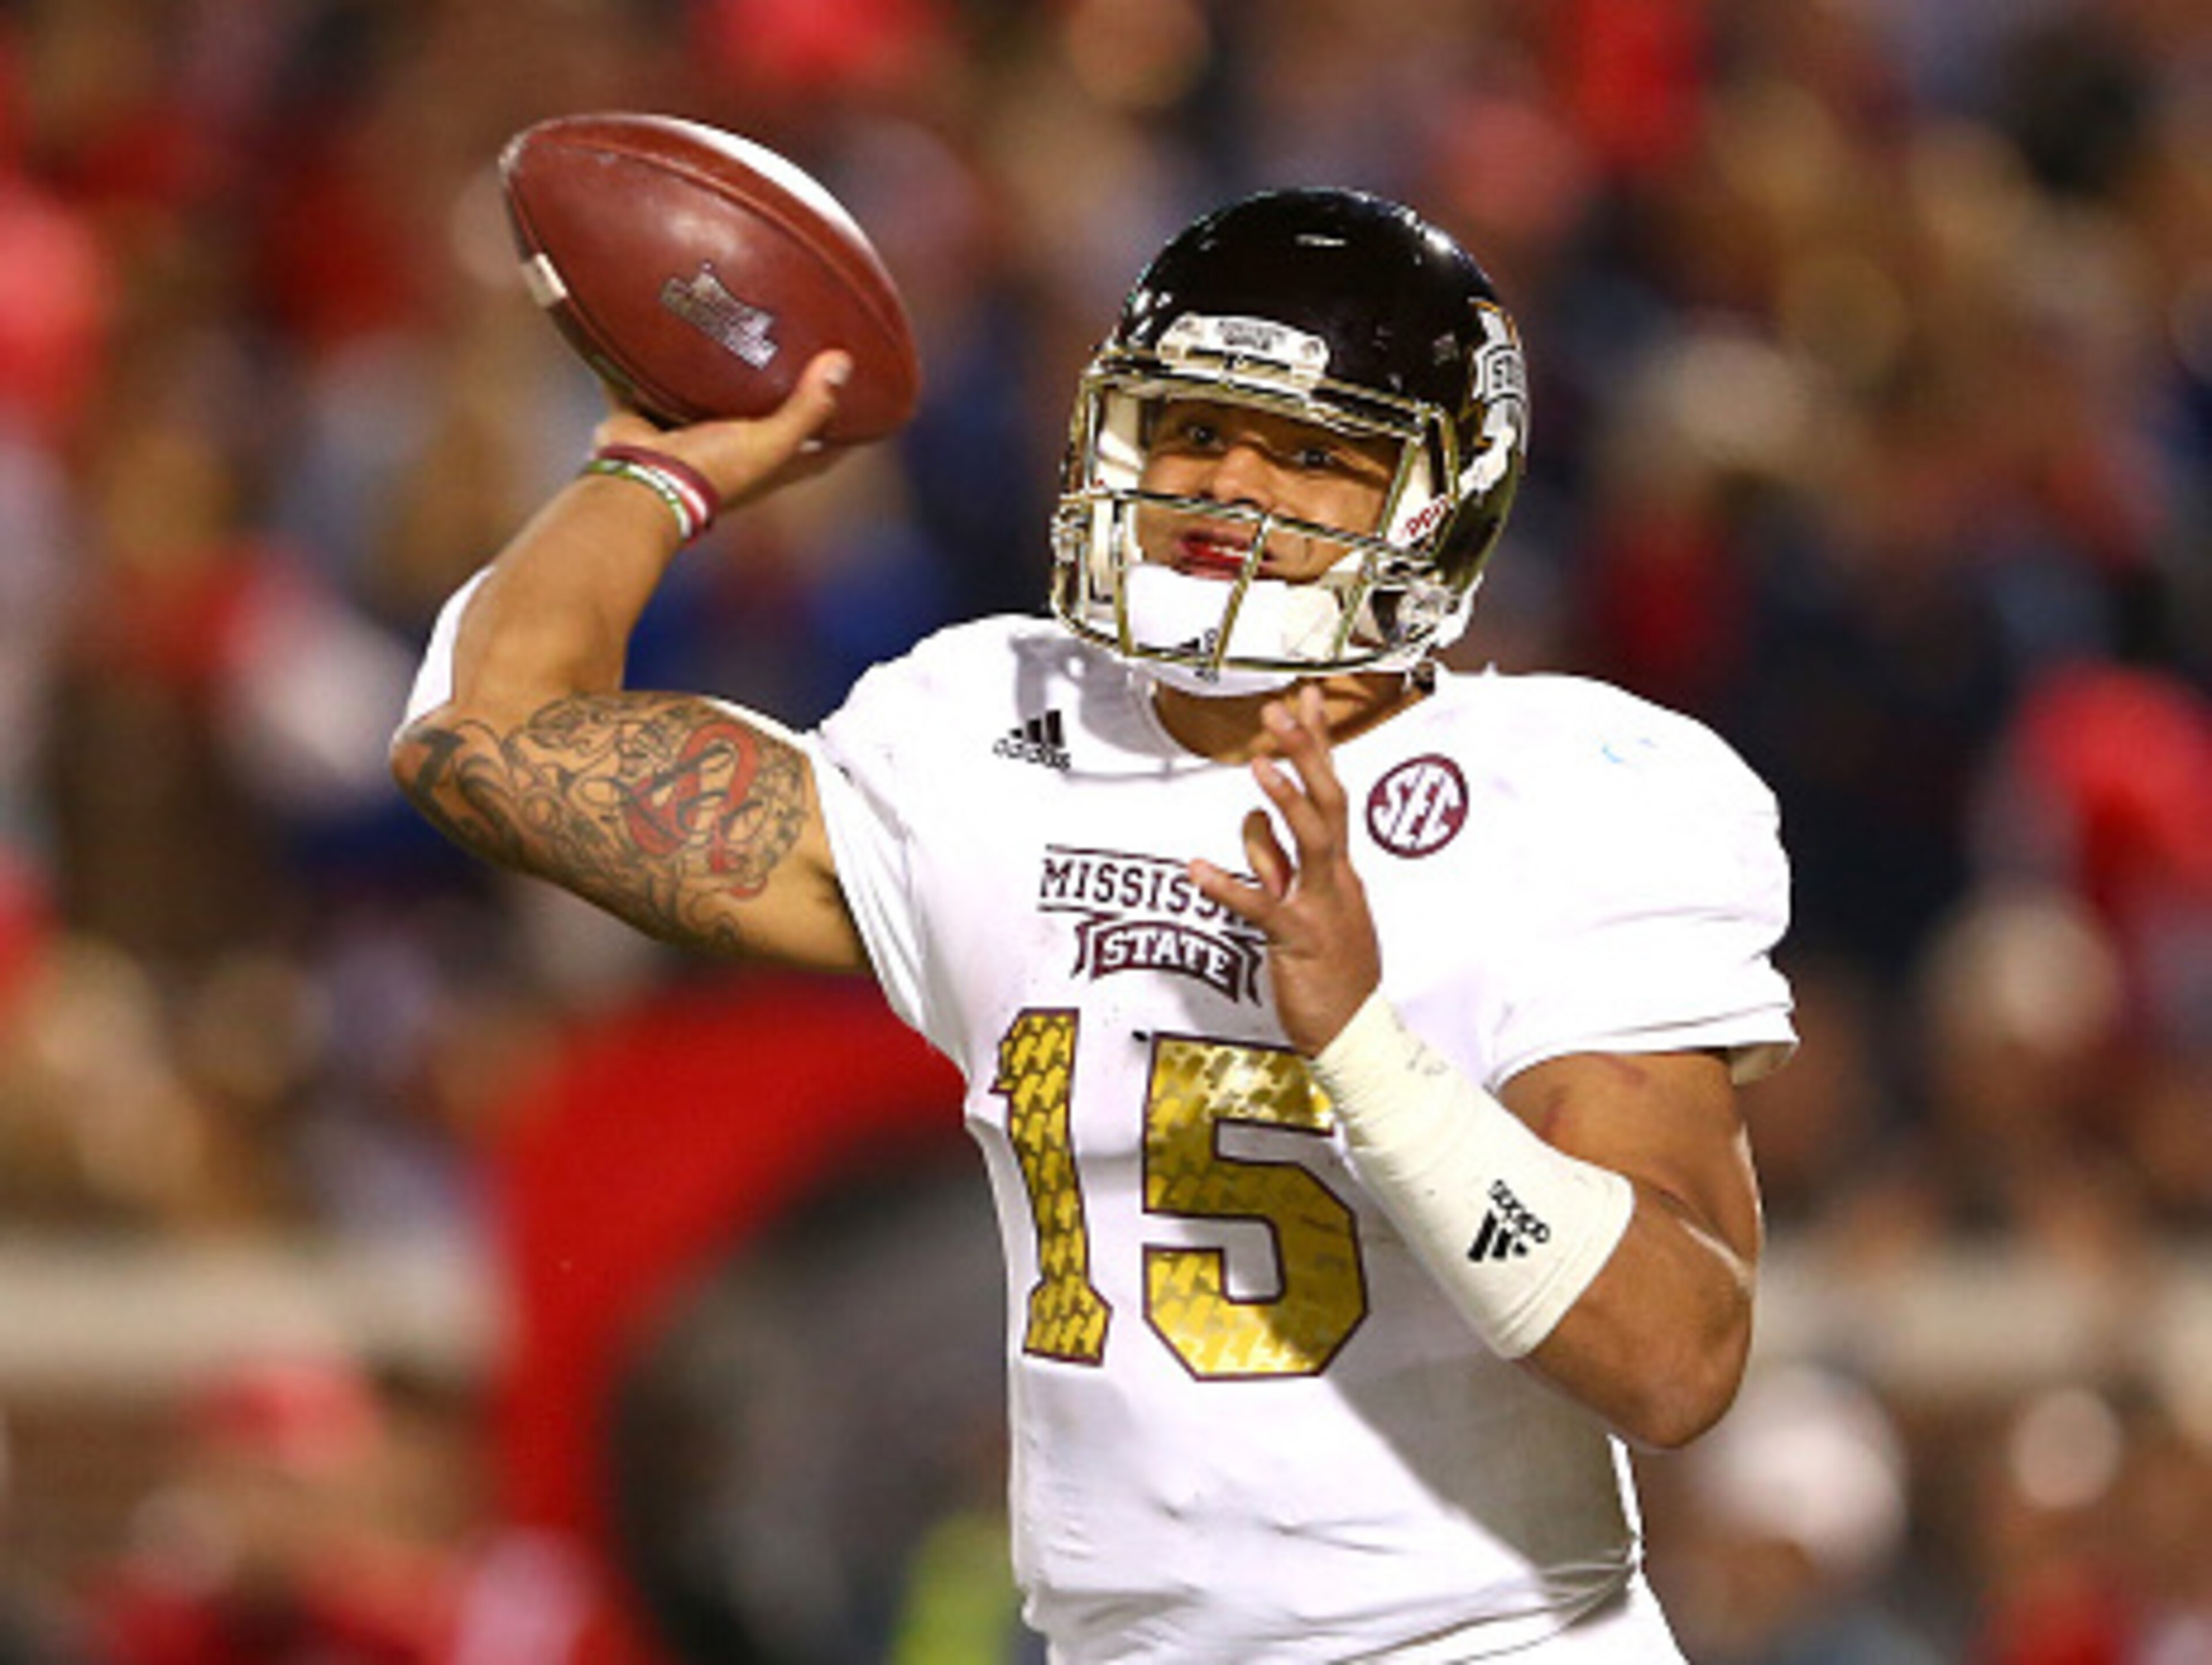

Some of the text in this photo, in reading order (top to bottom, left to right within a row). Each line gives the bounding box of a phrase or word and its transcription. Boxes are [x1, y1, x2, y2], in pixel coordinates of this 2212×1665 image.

[1372, 763, 1462, 852] SEC
[1103, 929, 1229, 983] STATE
[988, 1008, 1369, 1382] 15
